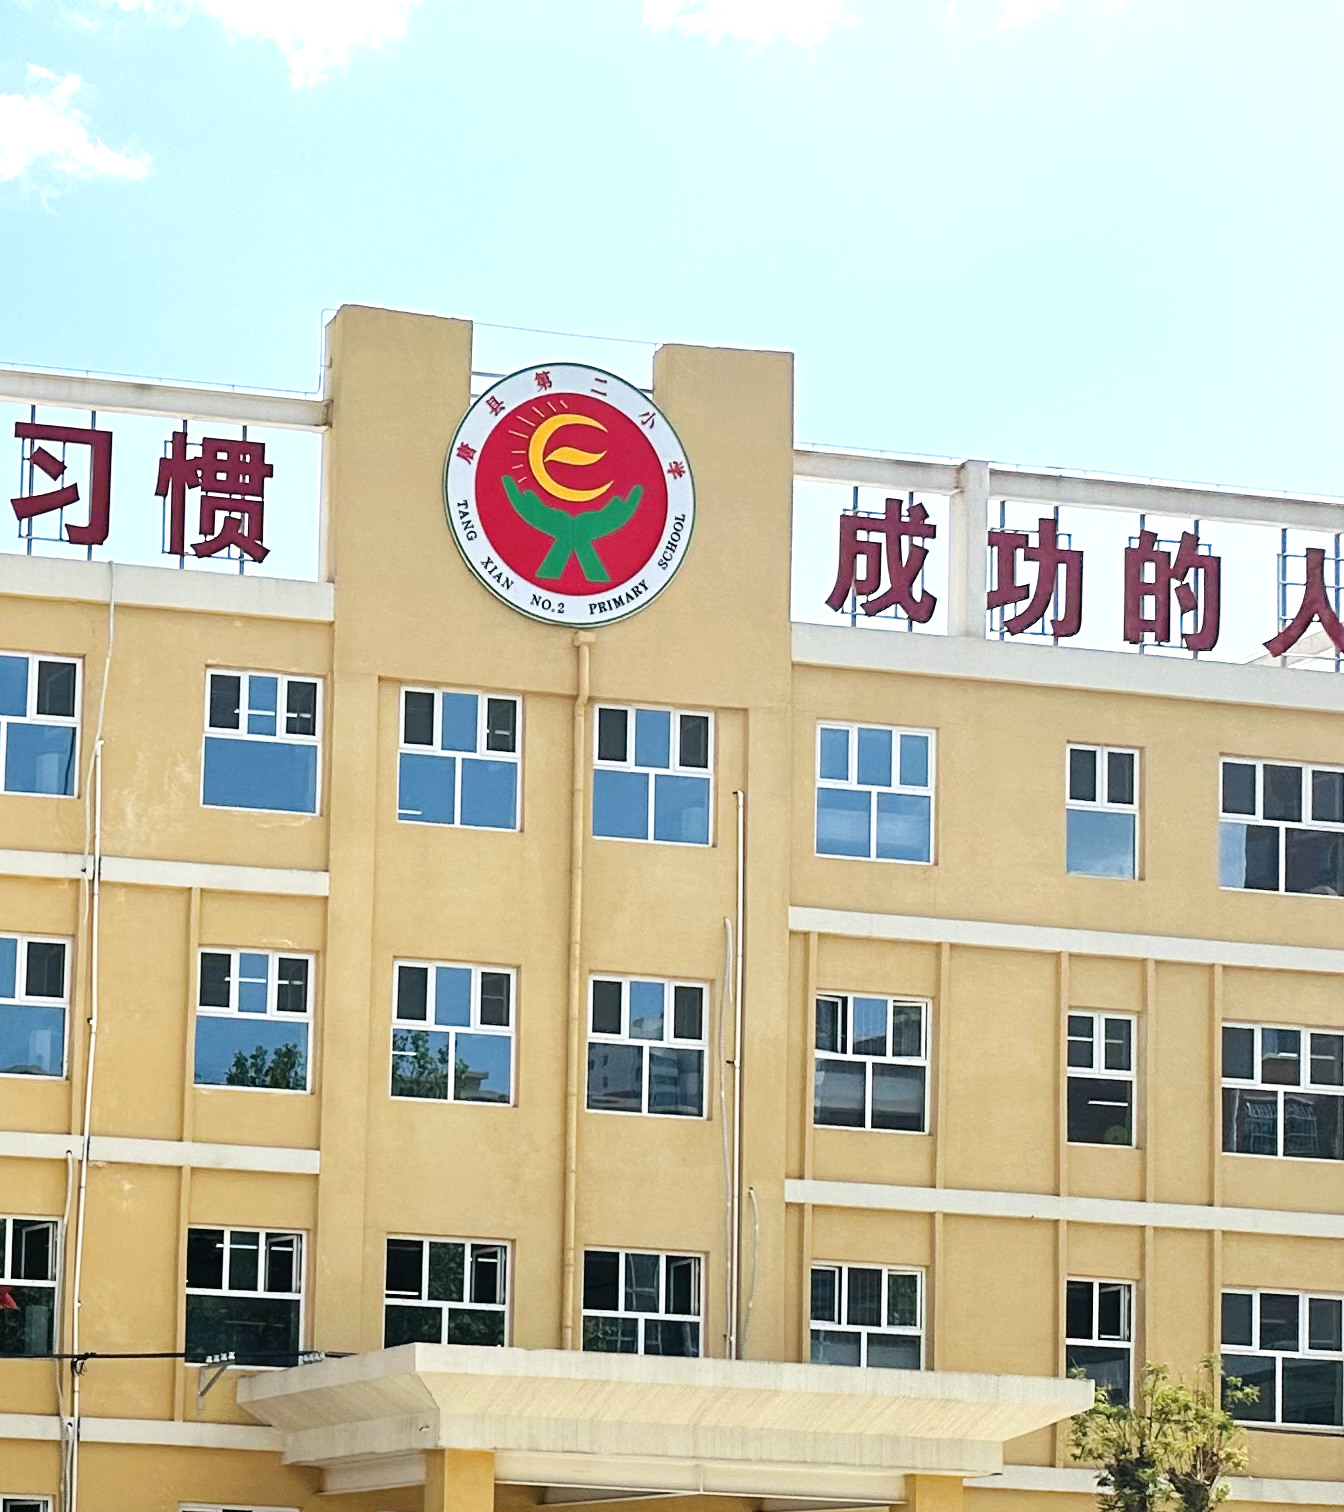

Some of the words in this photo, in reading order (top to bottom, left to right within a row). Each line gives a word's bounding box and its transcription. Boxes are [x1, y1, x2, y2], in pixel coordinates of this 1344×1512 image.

[456, 499, 478, 542] TANG
[480, 556, 514, 590] XIAN
[530, 594, 565, 614] NO.2
[588, 578, 650, 615] PRIMARY
[658, 513, 687, 570] SCHOOL
